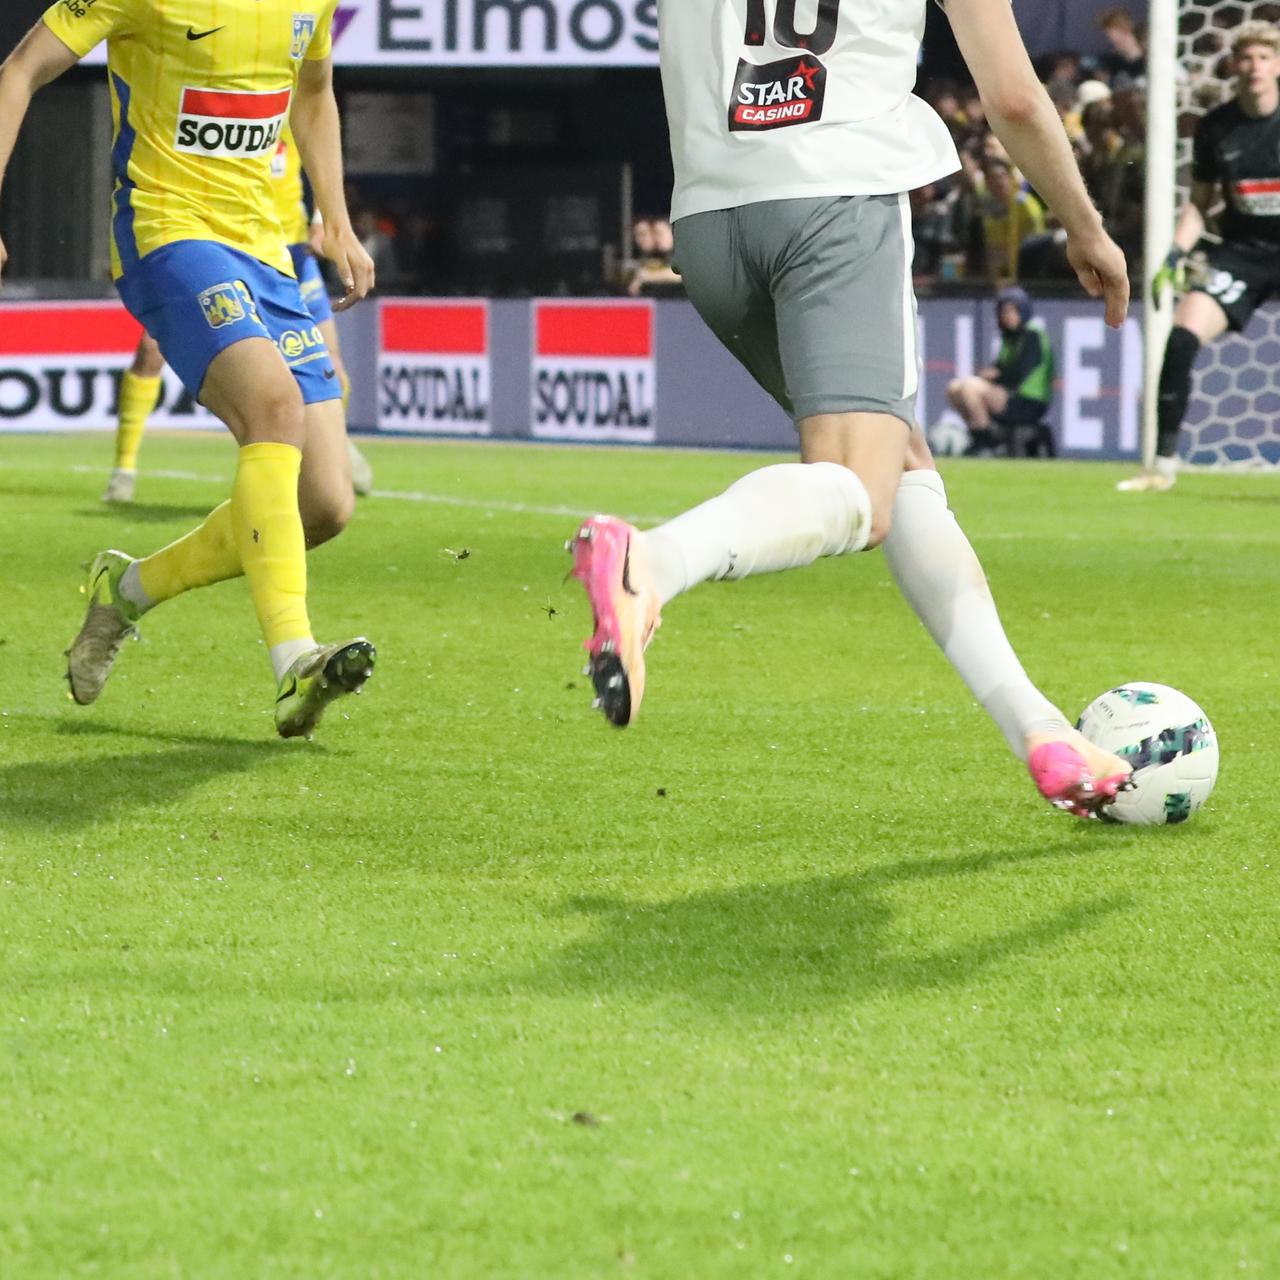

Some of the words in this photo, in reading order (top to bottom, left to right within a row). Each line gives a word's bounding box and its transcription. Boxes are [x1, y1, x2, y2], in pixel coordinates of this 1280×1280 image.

[737, 76, 807, 106] STAR
[741, 103, 807, 122] CASINO
[381, 366, 487, 418] SOUDAL
[536, 369, 650, 427] SOUDAL
